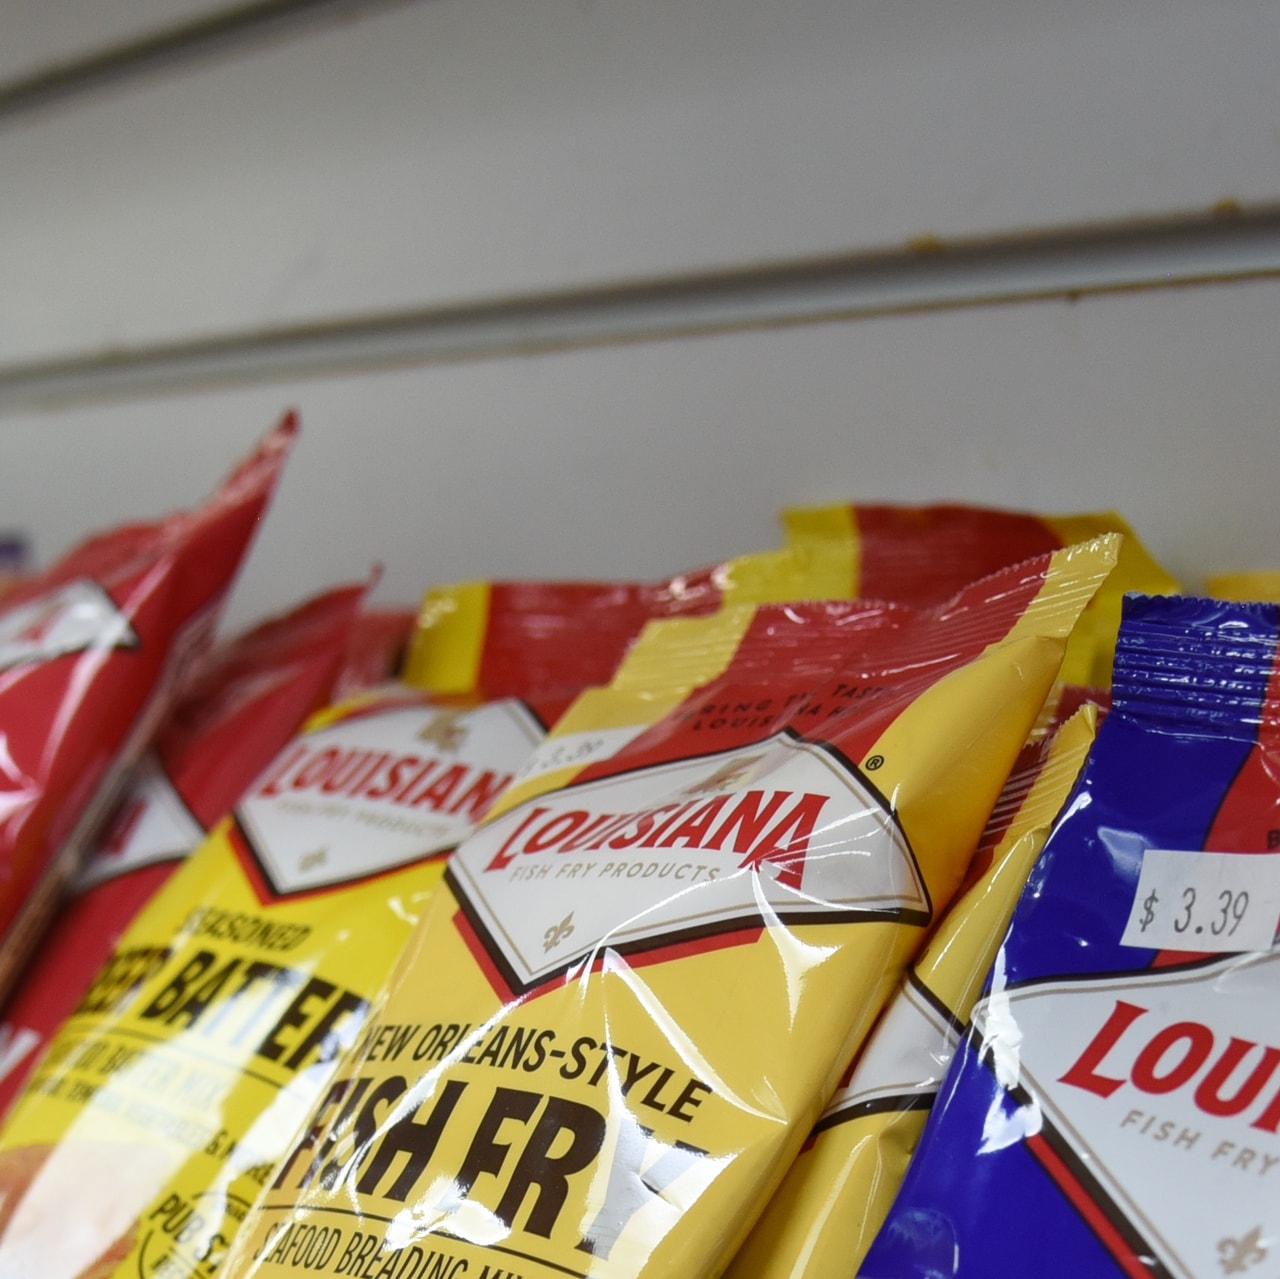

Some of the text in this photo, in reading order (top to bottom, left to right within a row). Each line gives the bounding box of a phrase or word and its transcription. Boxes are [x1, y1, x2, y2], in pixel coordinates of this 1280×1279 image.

[257, 742, 514, 823] LOUISIAN
[483, 789, 831, 891] LOUISIANA
[509, 860, 722, 884] FISH FRY PRODUCTS
[1137, 886, 1250, 936] $ 3.39
[352, 1023, 422, 1064] NEW
[272, 1074, 470, 1203] FISH
[1120, 1108, 1202, 1151] FISH
[1211, 1140, 1280, 1177] FRY
